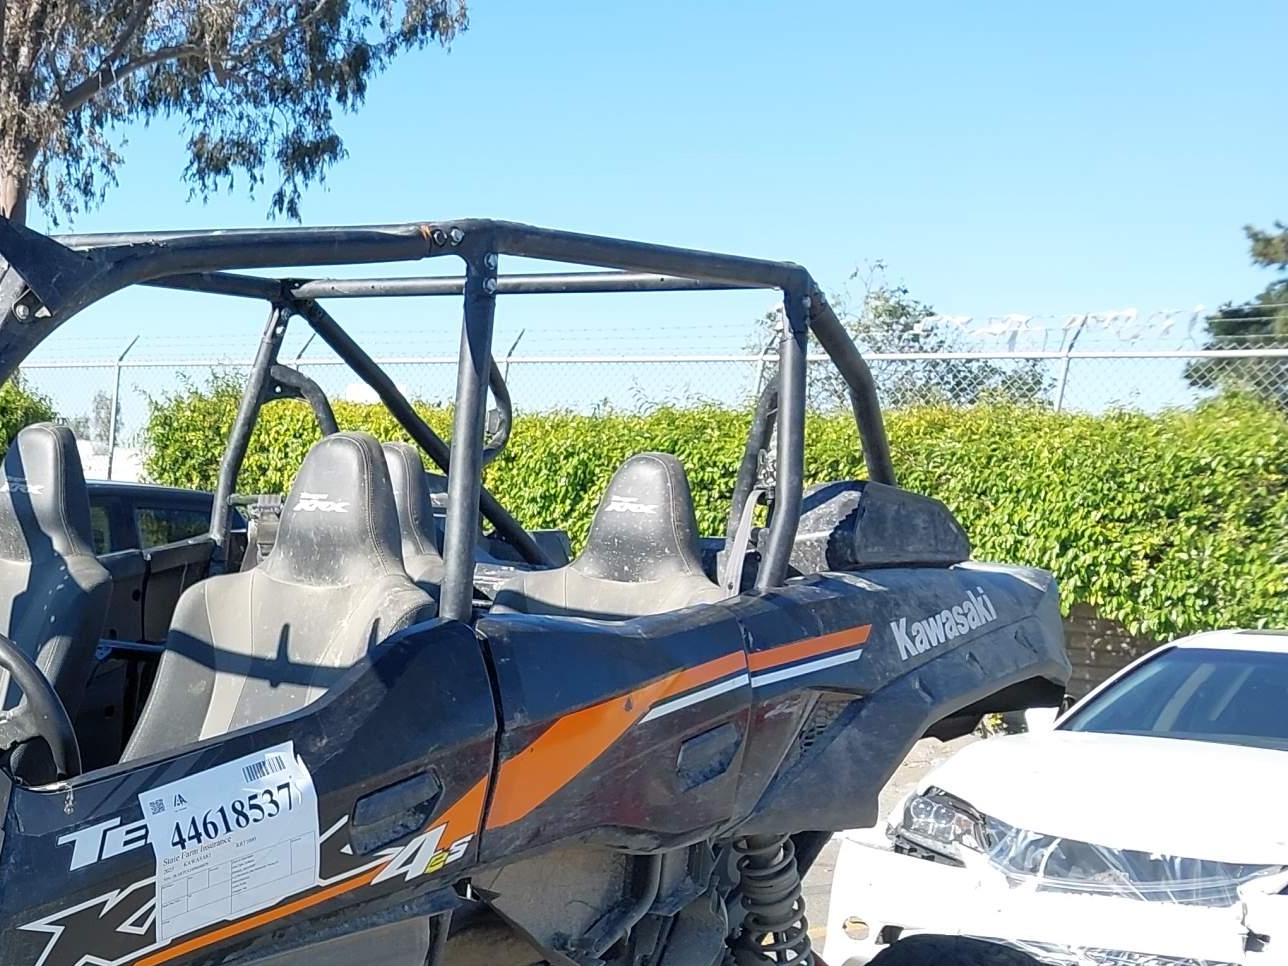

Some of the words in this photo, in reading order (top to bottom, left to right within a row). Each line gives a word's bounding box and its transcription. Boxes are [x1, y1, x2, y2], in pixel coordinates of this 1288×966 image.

[890, 586, 997, 661] Kawasaki
[171, 782, 293, 850] 44618537
[163, 855, 180, 867] State
[181, 848, 199, 860] Farm
[200, 836, 232, 853] Insurance
